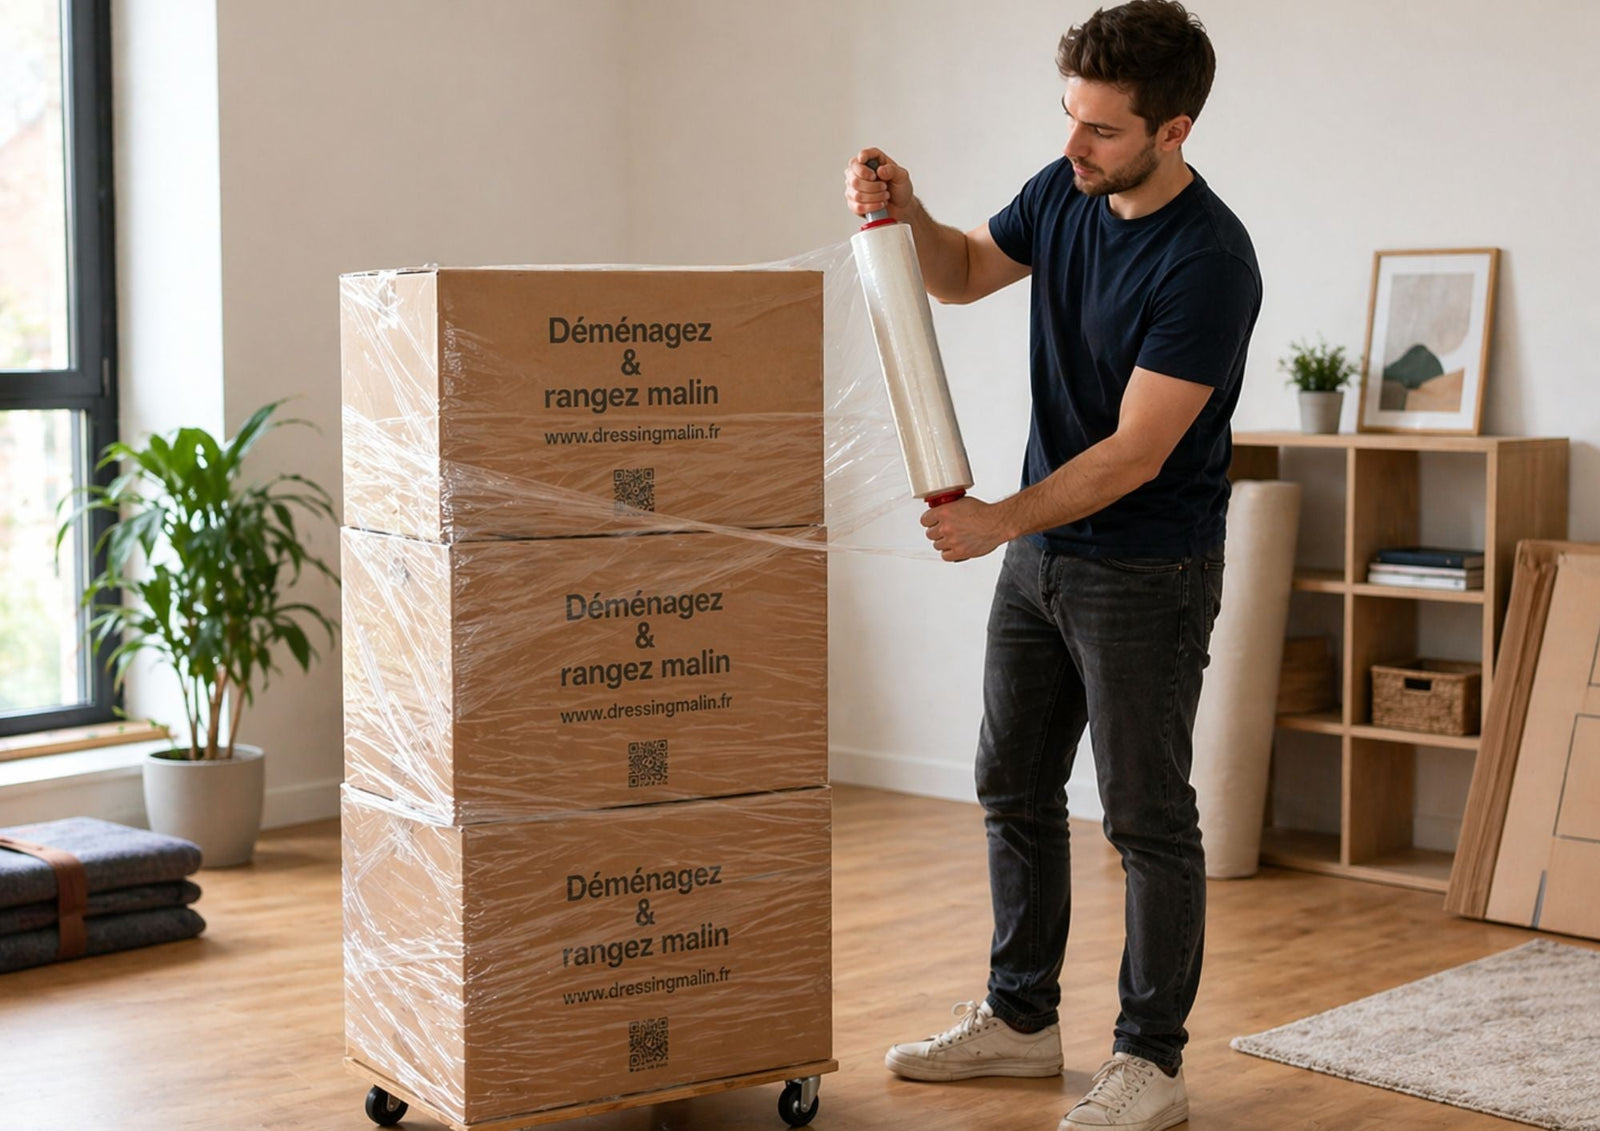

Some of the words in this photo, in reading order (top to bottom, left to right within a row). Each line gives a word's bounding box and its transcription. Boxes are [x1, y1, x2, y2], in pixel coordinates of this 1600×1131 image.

[549, 316, 712, 348] Déménagez
[621, 349, 641, 376] &
[545, 387, 639, 414] rangez
[648, 379, 718, 405] malin
[545, 424, 721, 445] www.dressingmalin.fr
[566, 590, 723, 621] Déménagez
[635, 622, 655, 649] &
[560, 660, 653, 689] rangez
[661, 649, 730, 678] malin
[560, 693, 732, 724] www.dressingmalin.fr
[566, 865, 722, 901] Déménagez
[635, 899, 656, 927] &
[562, 938, 654, 968] rangez
[662, 922, 729, 954] malin
[563, 966, 731, 1005] www.dressingmalin.fr
